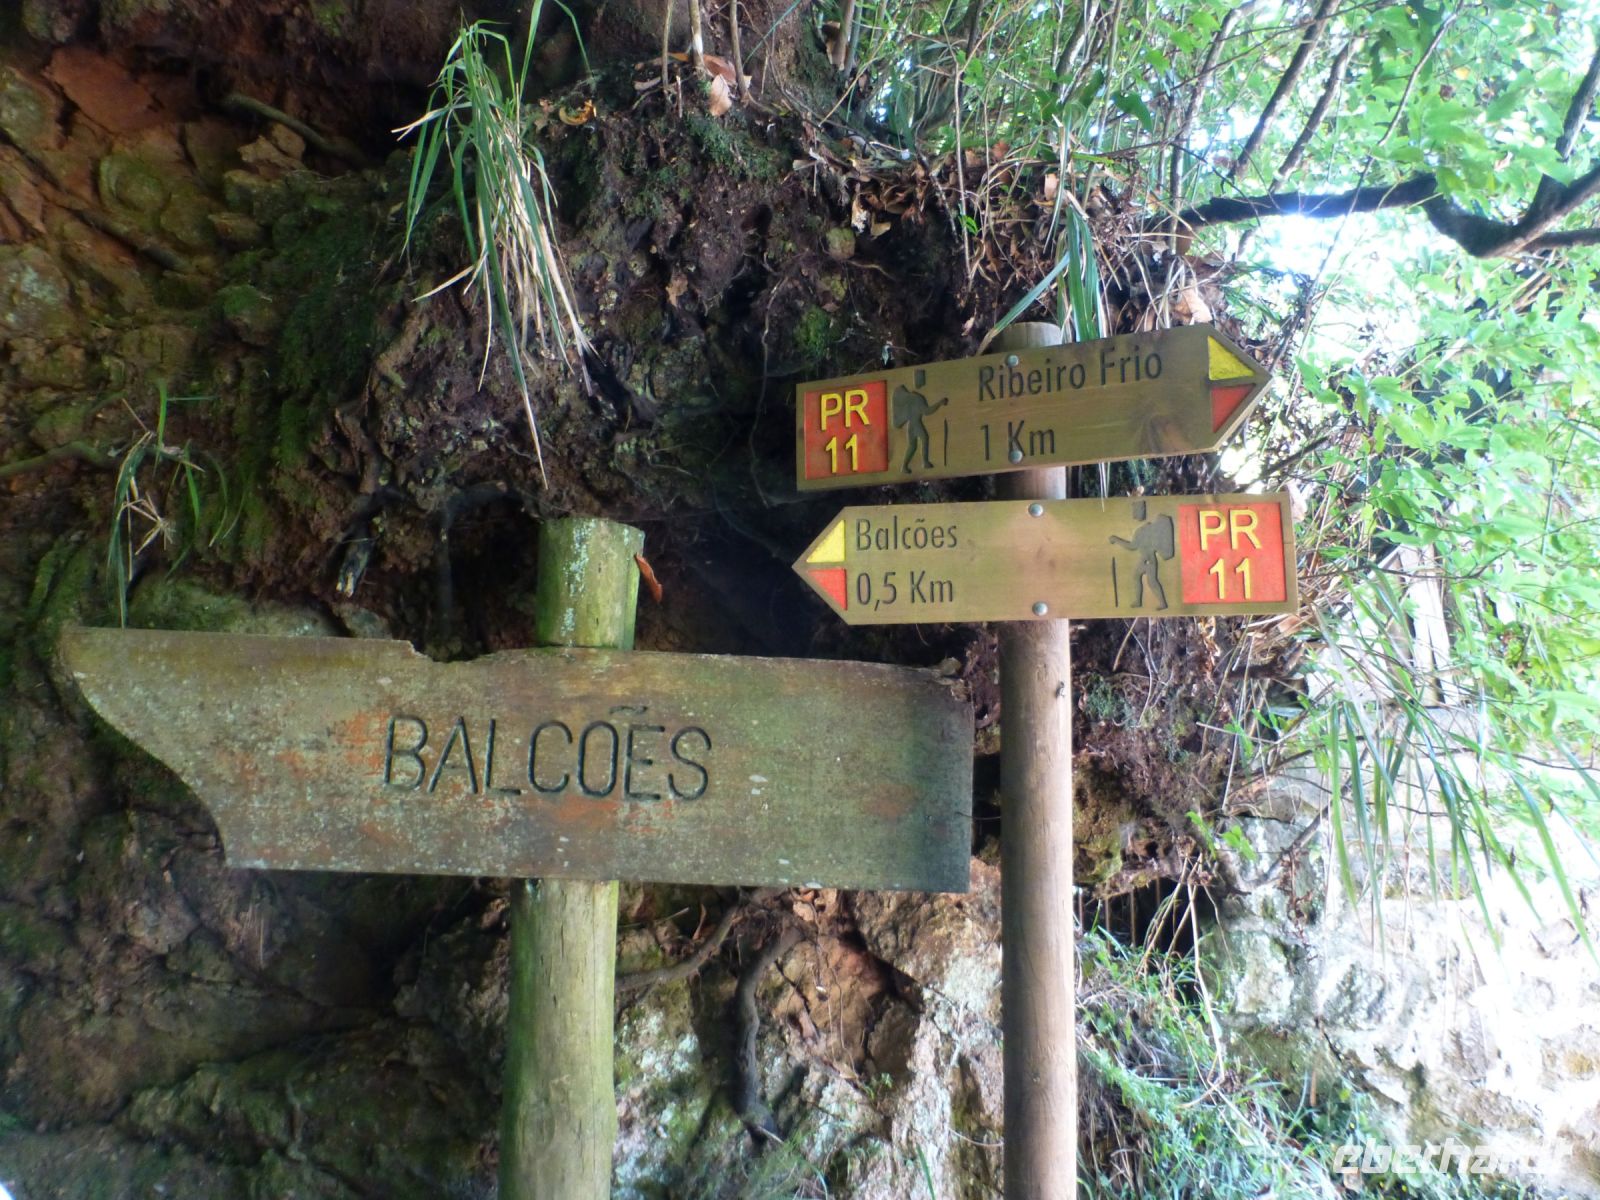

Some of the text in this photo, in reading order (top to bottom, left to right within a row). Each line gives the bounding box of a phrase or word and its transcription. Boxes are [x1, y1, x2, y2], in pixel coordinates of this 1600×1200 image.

[979, 347, 1163, 401] Ribeiro Frio
[819, 388, 870, 431] PR
[825, 434, 859, 474] 11
[981, 419, 1056, 461] 1 Km
[856, 518, 958, 552] Balcões
[1199, 509, 1263, 552] PR
[856, 571, 953, 612] 0,5 Km
[1209, 557, 1252, 600] 11
[382, 704, 713, 800] BALCÕES
